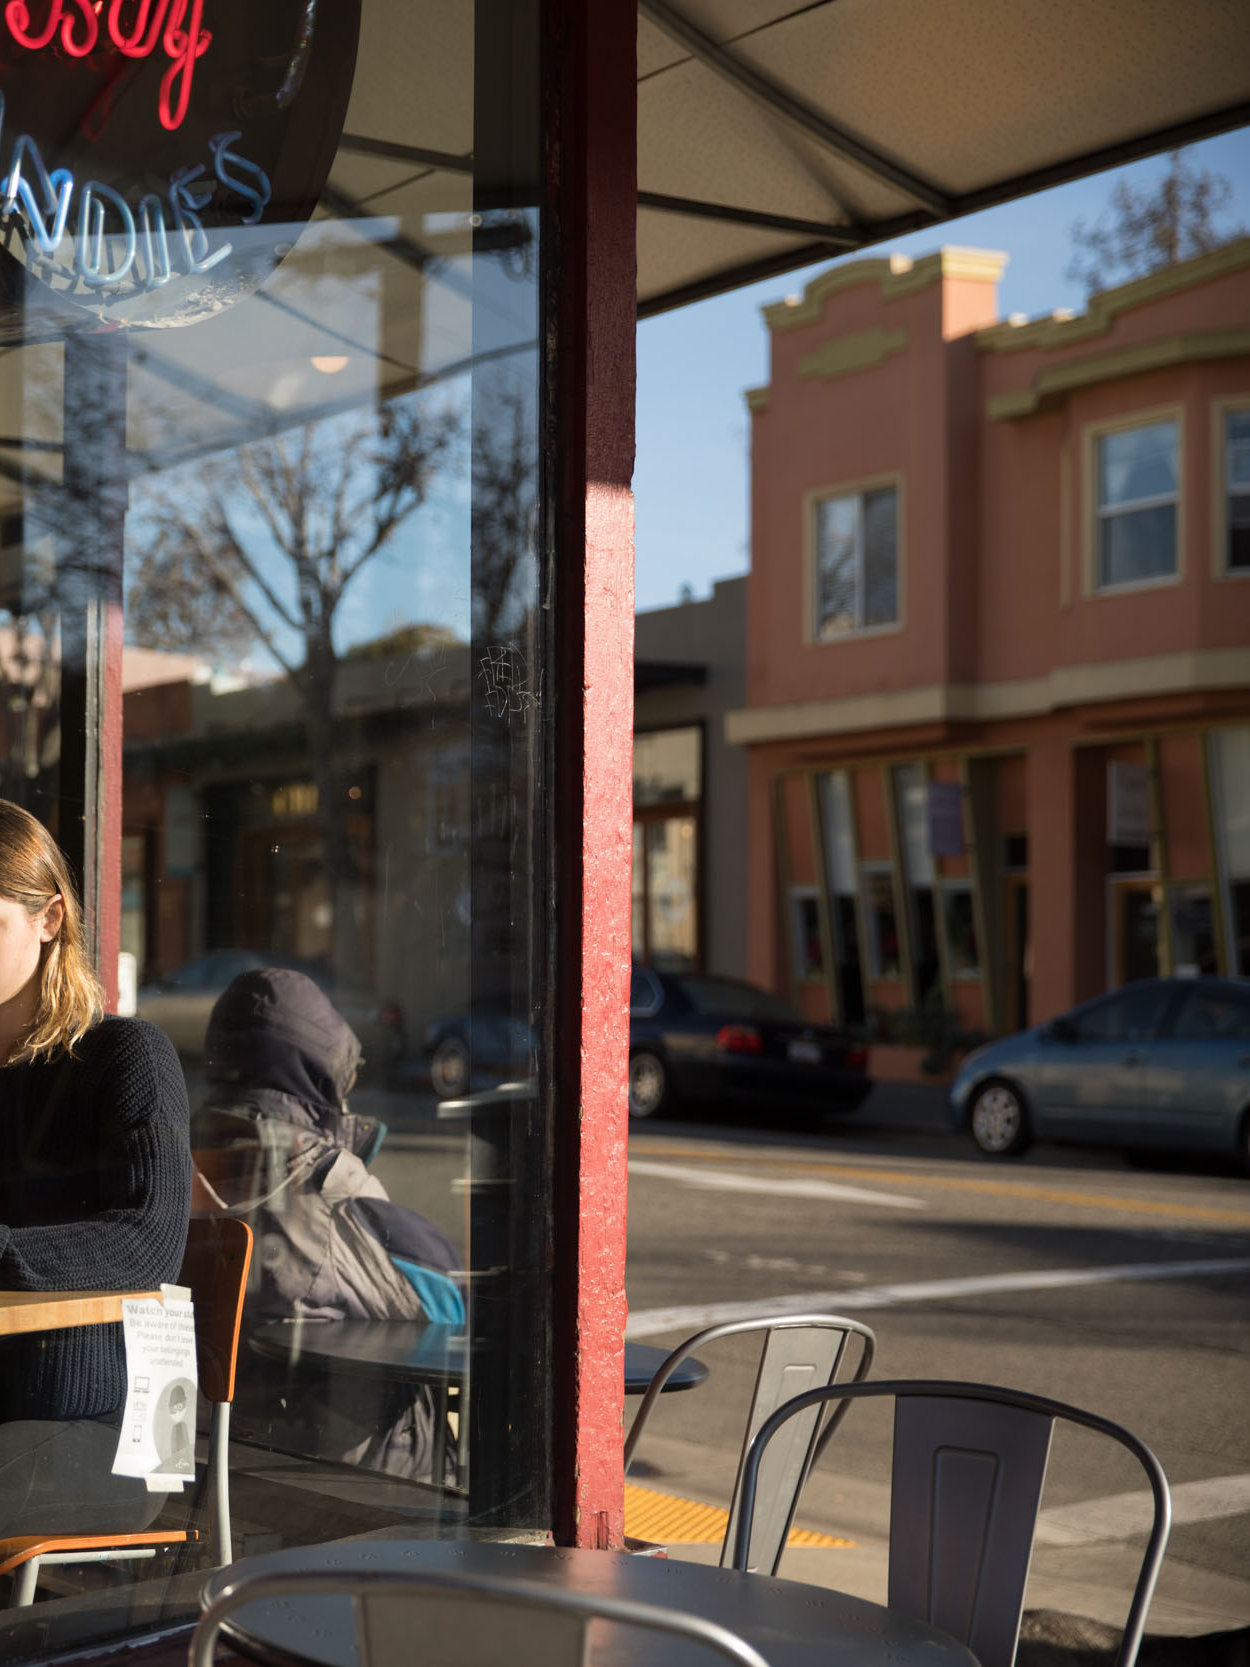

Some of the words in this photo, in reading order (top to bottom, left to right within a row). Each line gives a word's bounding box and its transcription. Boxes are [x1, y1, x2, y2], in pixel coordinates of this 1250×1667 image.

[126, 1304, 163, 1316] Watch
[165, 1309, 182, 1319] your
[129, 1318, 141, 1328] Be
[144, 1319, 168, 1329] aware
[170, 1320, 177, 1330] of
